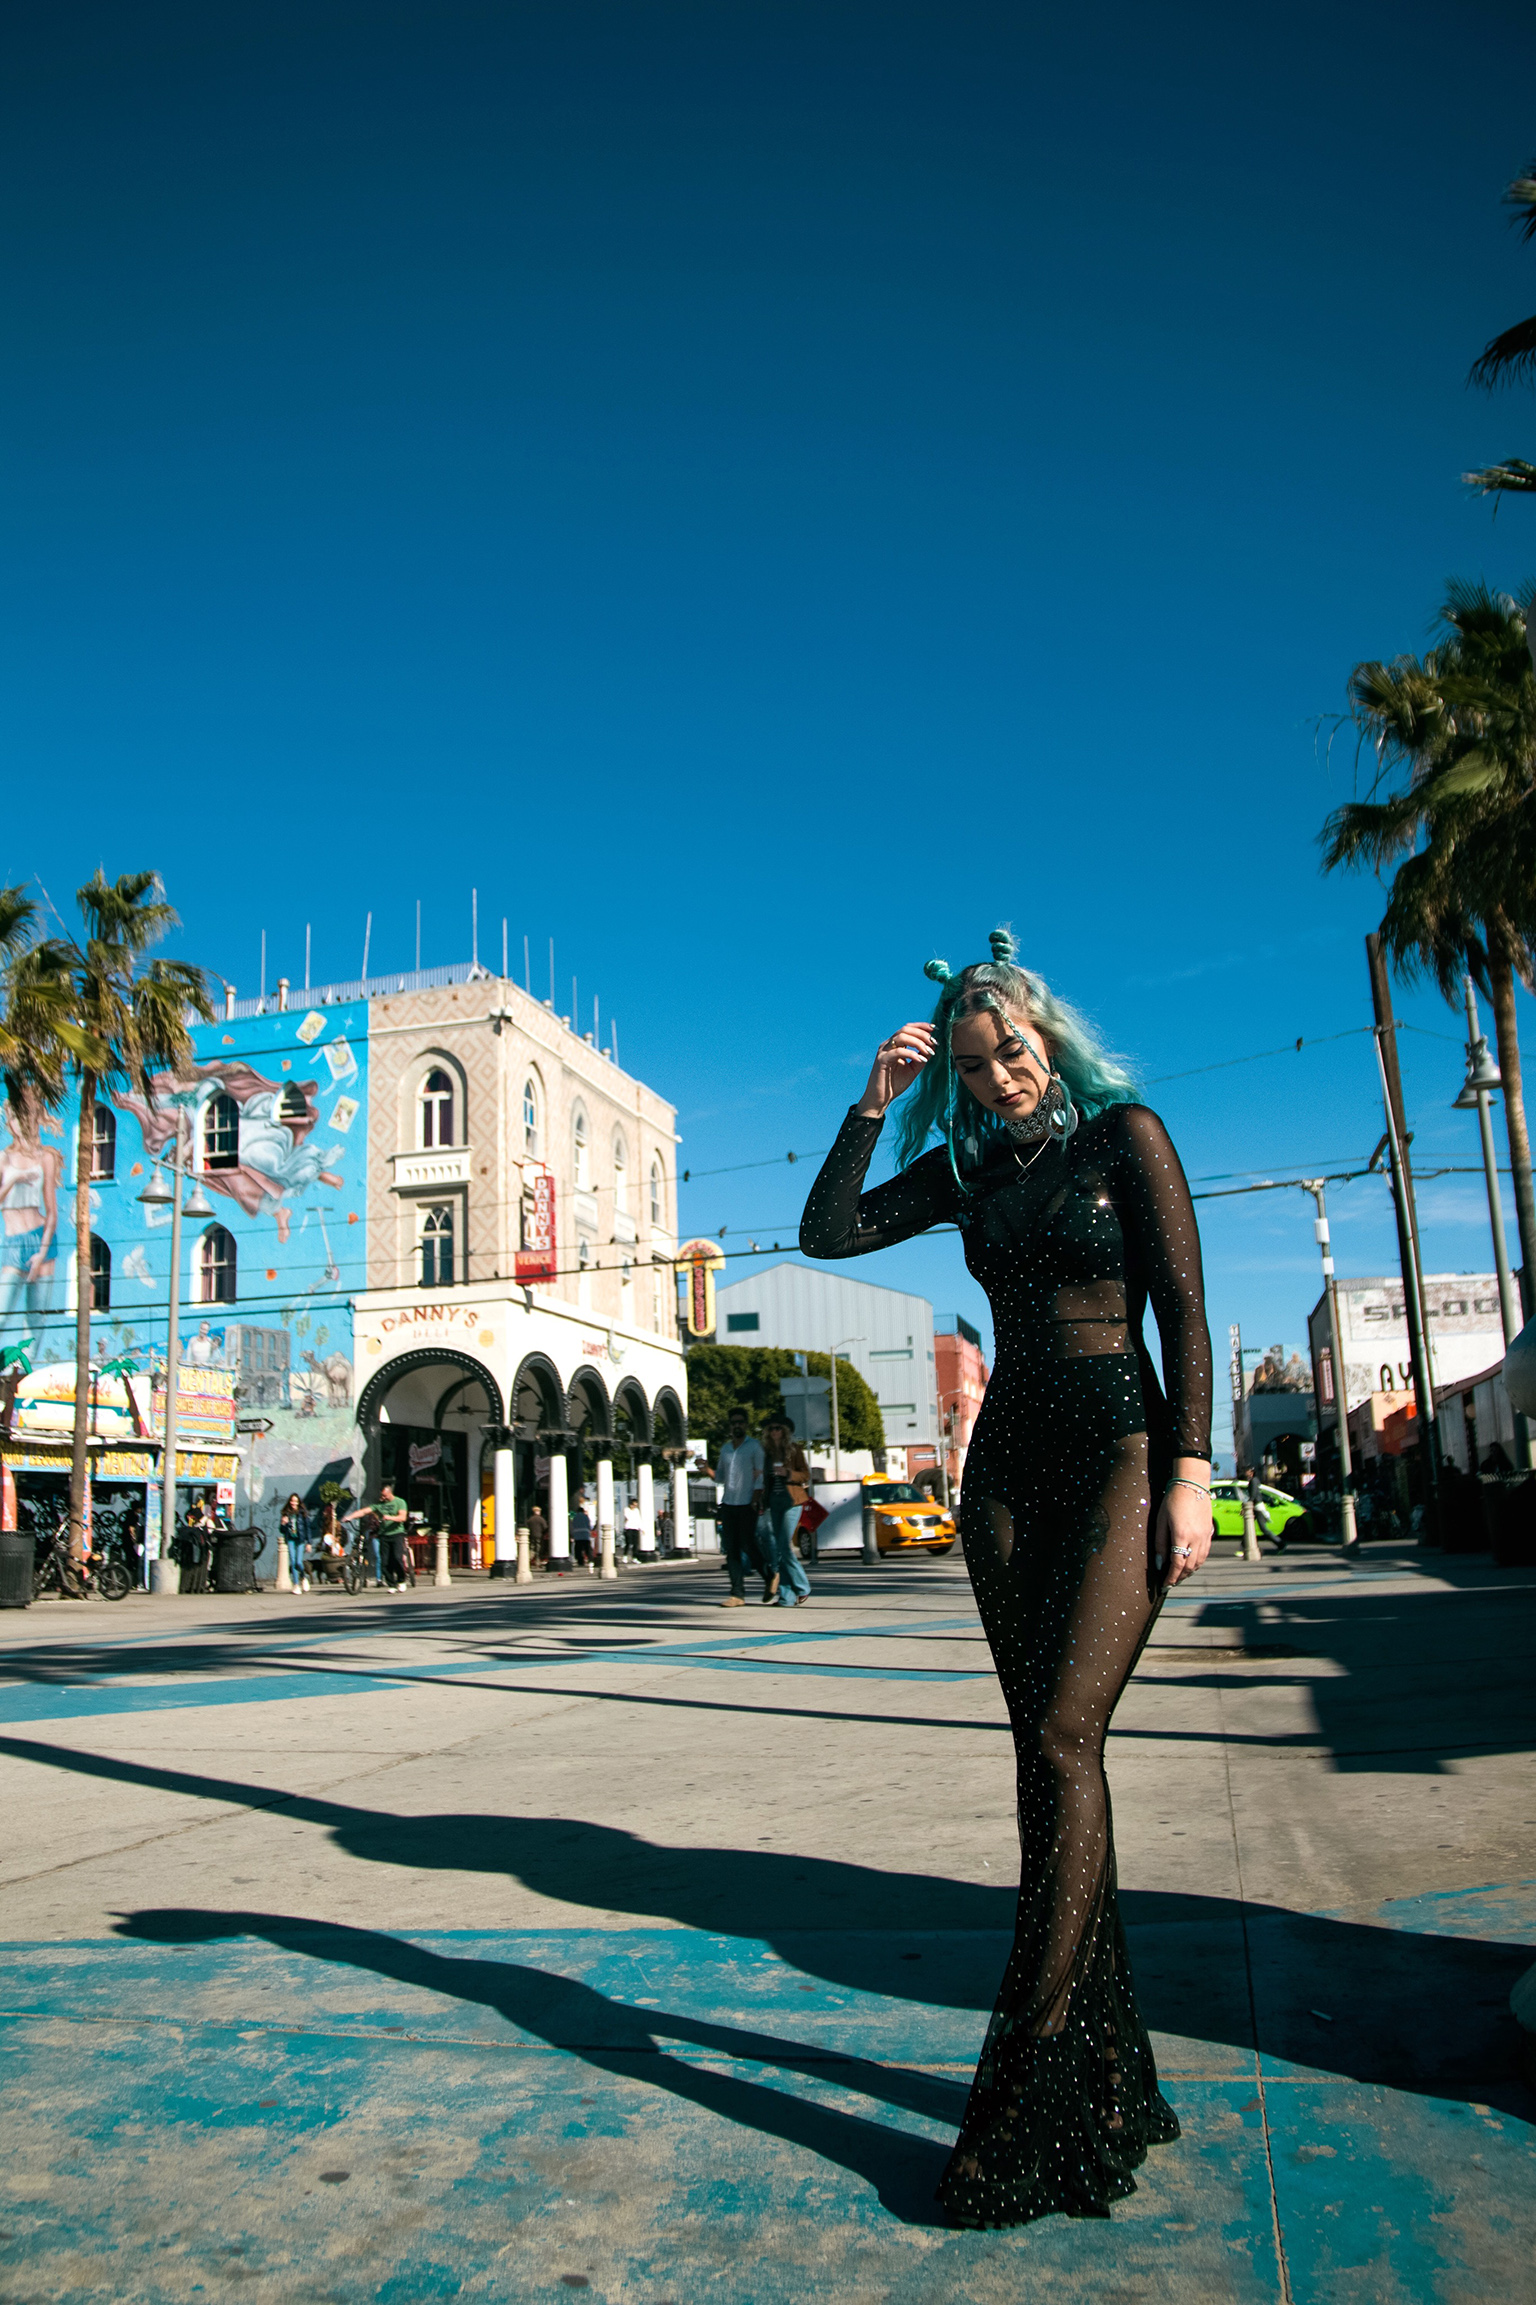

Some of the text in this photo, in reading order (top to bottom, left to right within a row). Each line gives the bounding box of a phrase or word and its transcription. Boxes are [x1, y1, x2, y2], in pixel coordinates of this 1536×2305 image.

[381, 1305, 479, 1332] DANNY'S
[1229, 1324, 1242, 1400] TATTOO
[178, 1367, 233, 1396] RENTALS
[103, 1451, 150, 1476] RENTALS
[220, 1488, 233, 1498] ATM
